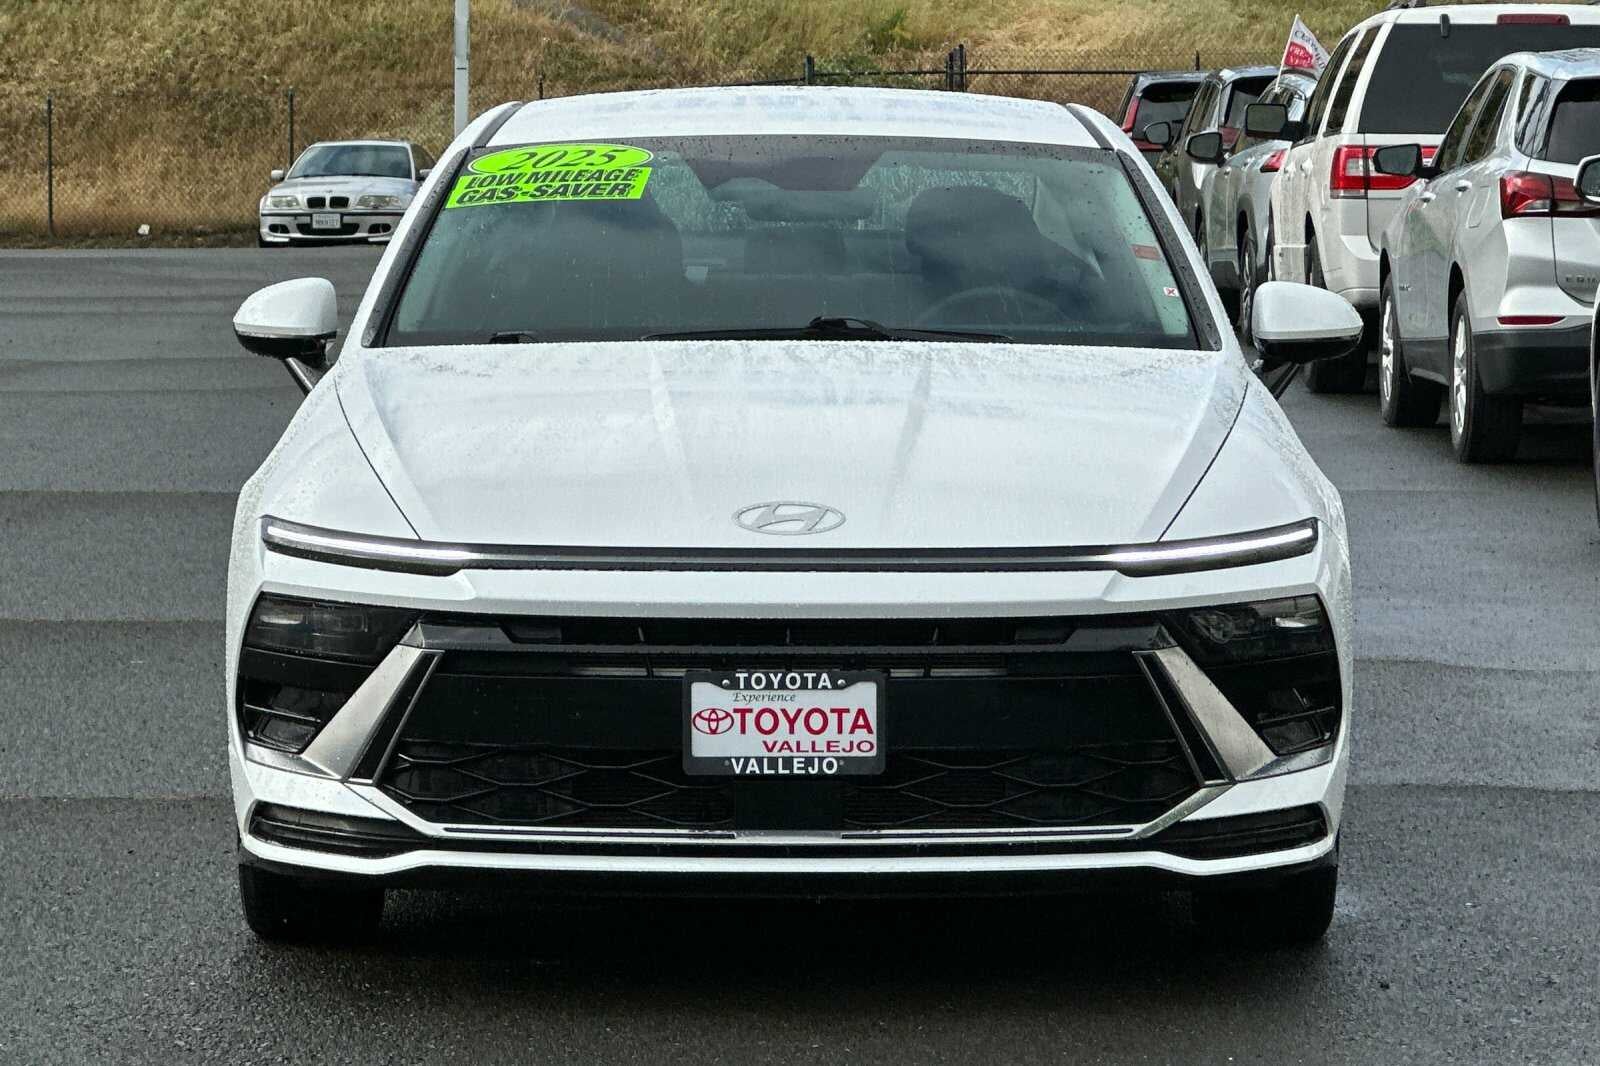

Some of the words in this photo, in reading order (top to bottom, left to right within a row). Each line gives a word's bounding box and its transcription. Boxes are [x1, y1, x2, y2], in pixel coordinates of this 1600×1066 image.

[499, 149, 628, 171] 2025
[463, 172, 525, 190] LOW
[524, 168, 641, 185] MILEAGE
[456, 183, 635, 205] GAS-SAVER
[735, 672, 833, 690] TOYOTA
[733, 691, 796, 704] Experience
[733, 707, 874, 735] TOYOTA
[762, 740, 875, 753] VALLEJO
[731, 757, 838, 775] VALLEJO
